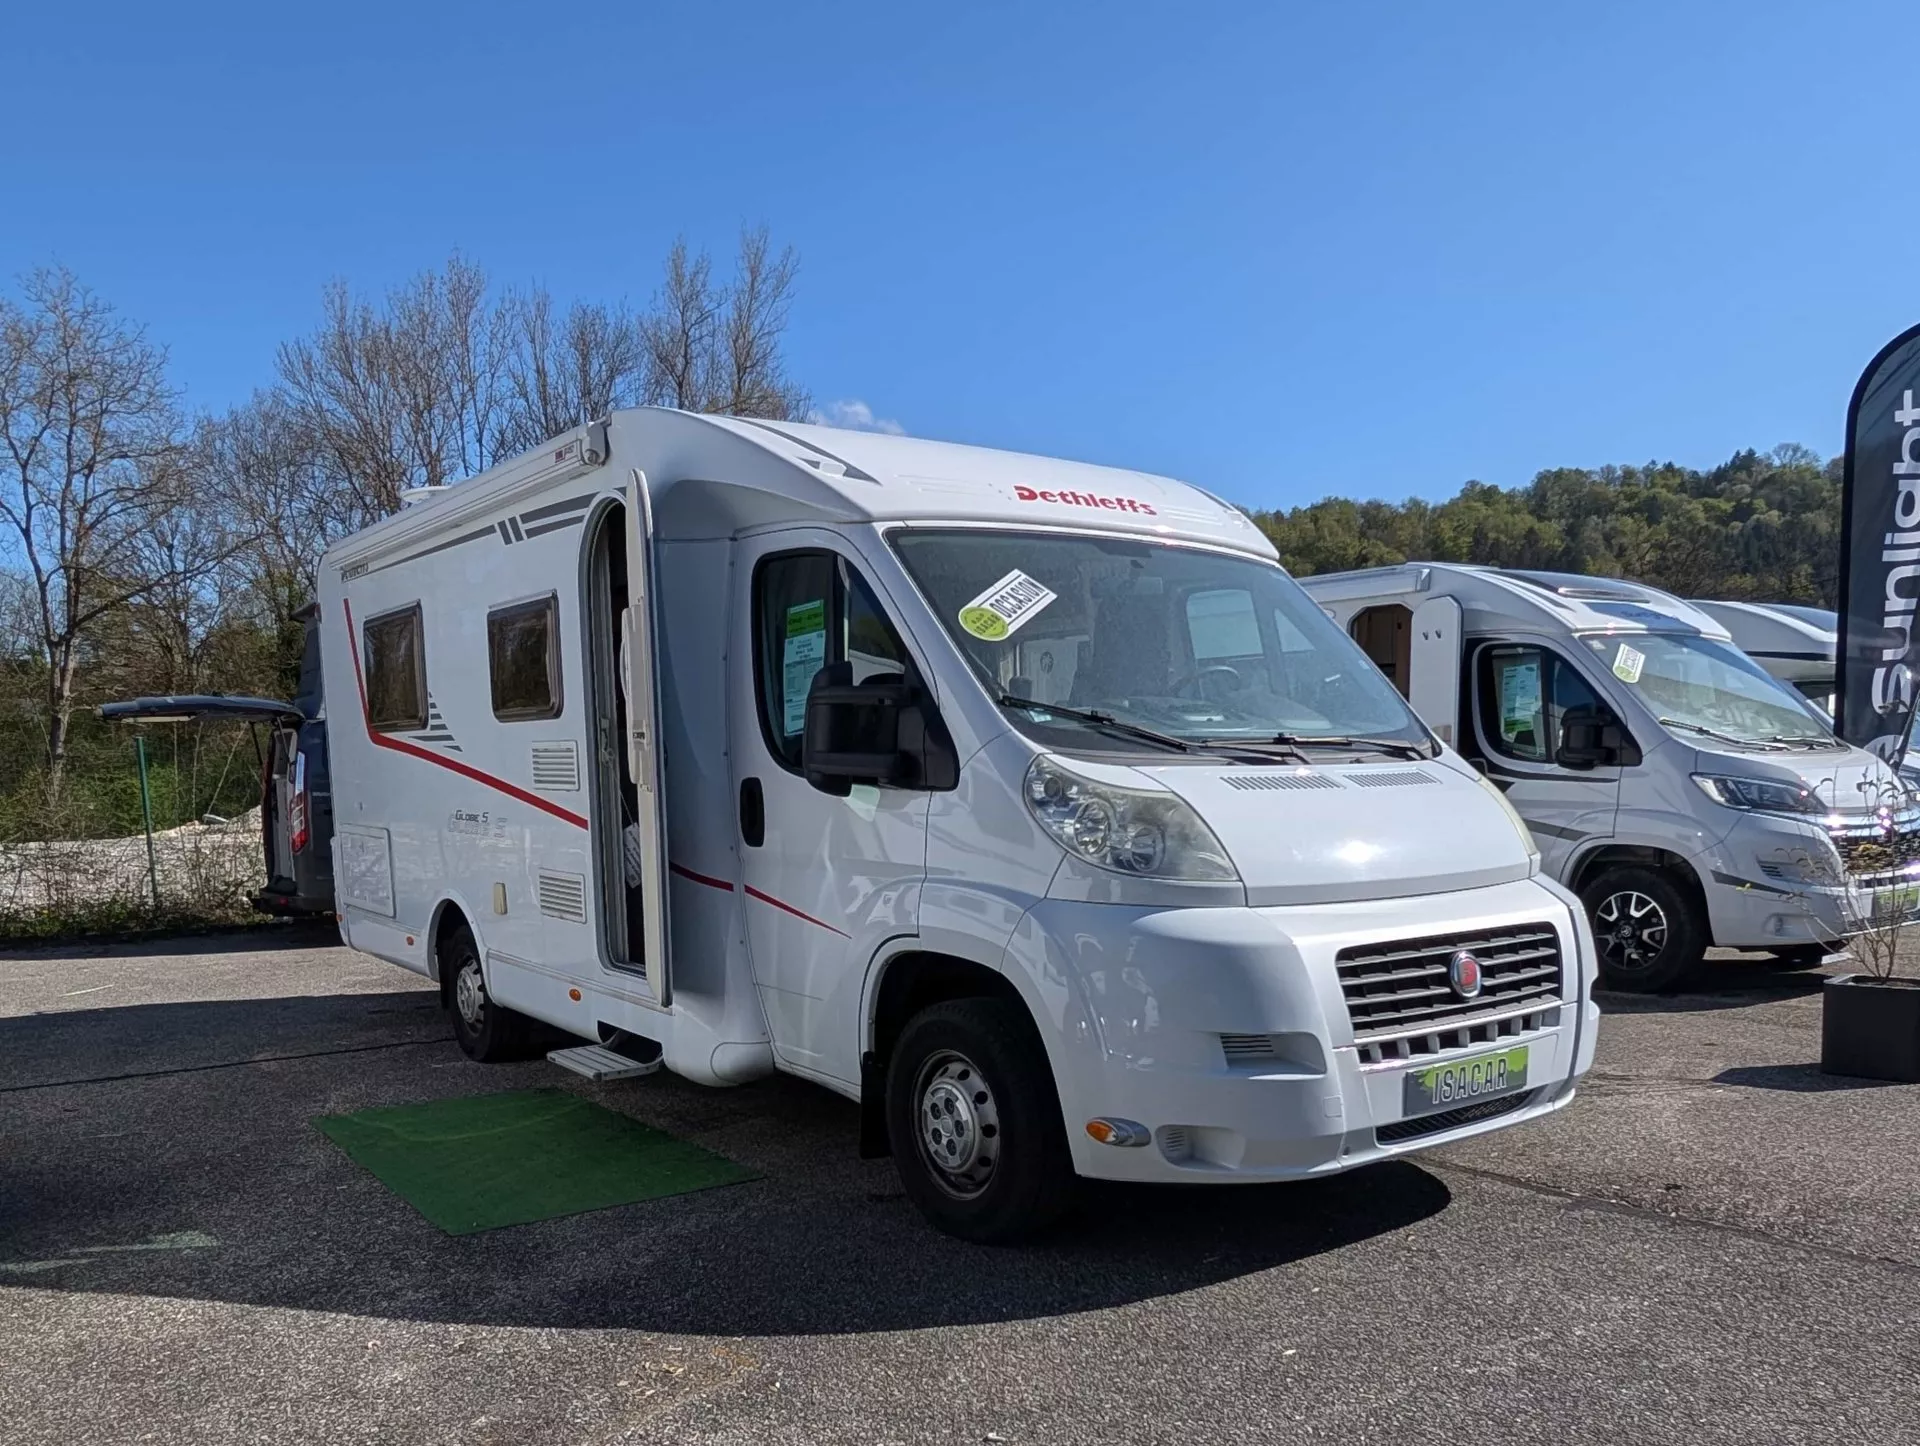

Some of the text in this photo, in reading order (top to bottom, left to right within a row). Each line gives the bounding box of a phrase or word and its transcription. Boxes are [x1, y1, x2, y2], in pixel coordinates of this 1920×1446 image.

[1013, 485, 1158, 516] Dethleffs
[988, 577, 1046, 619] OCCASION
[481, 811, 490, 823] S
[1432, 1057, 1508, 1105] ISACAR
